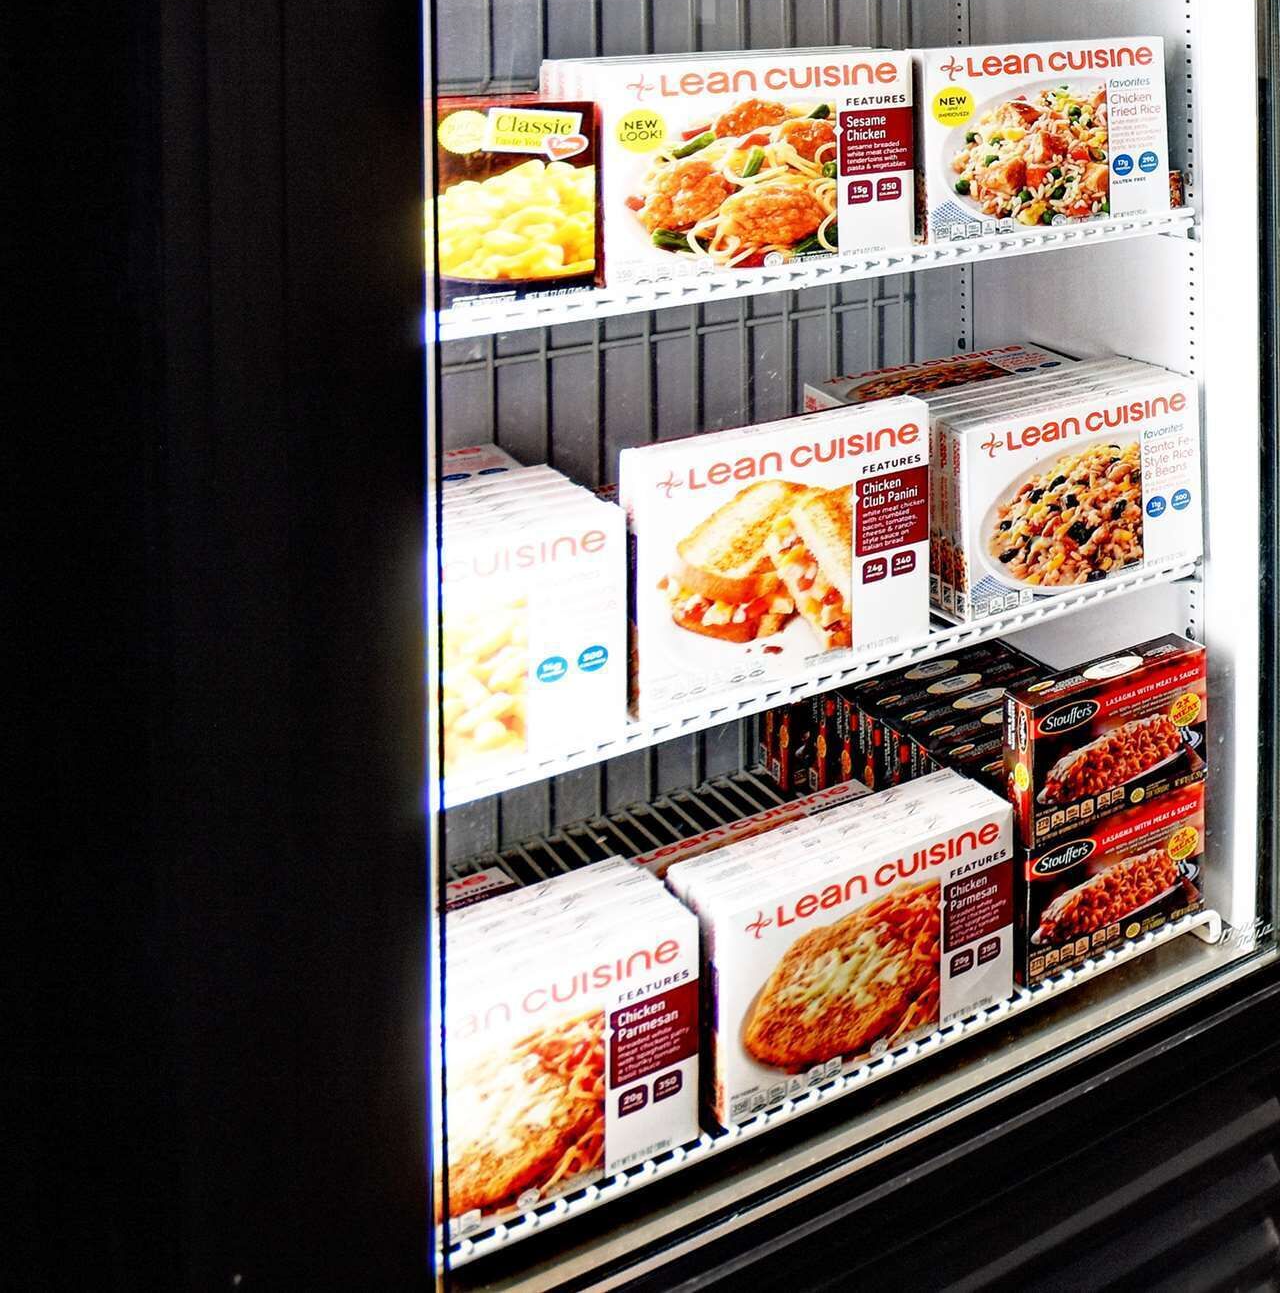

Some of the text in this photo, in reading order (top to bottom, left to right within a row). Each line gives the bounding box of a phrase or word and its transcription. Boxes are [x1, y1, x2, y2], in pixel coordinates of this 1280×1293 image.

[966, 51, 1044, 78] Lean
[660, 69, 757, 97] Lean
[1109, 76, 1151, 88] favorites
[845, 94, 906, 107] FEATURES
[939, 96, 967, 106] NEW
[1110, 92, 1152, 104] Chicken
[1111, 104, 1161, 117] Fried Rice
[496, 113, 572, 136] Classic
[624, 119, 658, 131] NEW
[846, 115, 887, 128] Sesame
[619, 130, 663, 141] LOOK!
[846, 129, 886, 142] Chicken
[847, 140, 900, 150] sesame breaded
[846, 150, 865, 158] white
[883, 146, 908, 155] chicken
[847, 154, 897, 165] tenderloins with
[847, 161, 907, 173] pasta vegetables
[1117, 159, 1129, 168] 17g
[853, 182, 897, 195] 15g 350
[842, 362, 919, 380] Lean
[1006, 416, 1080, 451] Lean
[1143, 422, 1185, 440] favorites
[1143, 435, 1194, 457] Santa Fe-
[861, 454, 922, 475] FEATURES
[1143, 447, 1194, 470] Style Rice
[688, 451, 782, 491] Lean
[1143, 462, 1188, 481] & Beans
[862, 478, 902, 495] Chicken
[862, 485, 918, 509] Club Panini
[1174, 493, 1188, 502] 300
[862, 498, 925, 518] white meat chicken
[862, 508, 910, 525] with crumbled
[862, 529, 886, 539] cheese
[862, 529, 910, 546] style sauce on
[862, 536, 904, 552] Italian bread
[866, 555, 912, 574] 24g 340
[1105, 690, 1137, 707] LASAGNA
[1137, 684, 1155, 695] WITH
[1155, 677, 1173, 691] MEAT
[1179, 668, 1200, 680] SAUCE
[1173, 701, 1199, 721] MEAT
[1176, 696, 1191, 709] 2X
[1045, 704, 1093, 731] Stouffer's
[1101, 801, 1198, 845] LASAGNA WITH MEAT & SAUCE
[636, 827, 725, 866] Lean
[1170, 835, 1196, 854] MEAT
[1173, 831, 1188, 844] 2X
[949, 848, 1007, 879] FEATURES
[1039, 842, 1089, 872] Stouffer's
[949, 875, 988, 899] Chicken
[776, 874, 867, 928] Lean
[949, 883, 998, 913] Parmesan
[617, 968, 690, 1004] FEATURES
[618, 999, 666, 1028] Chicken
[618, 1010, 679, 1043] Parmesan
[623, 1076, 678, 1106] 20g 350
